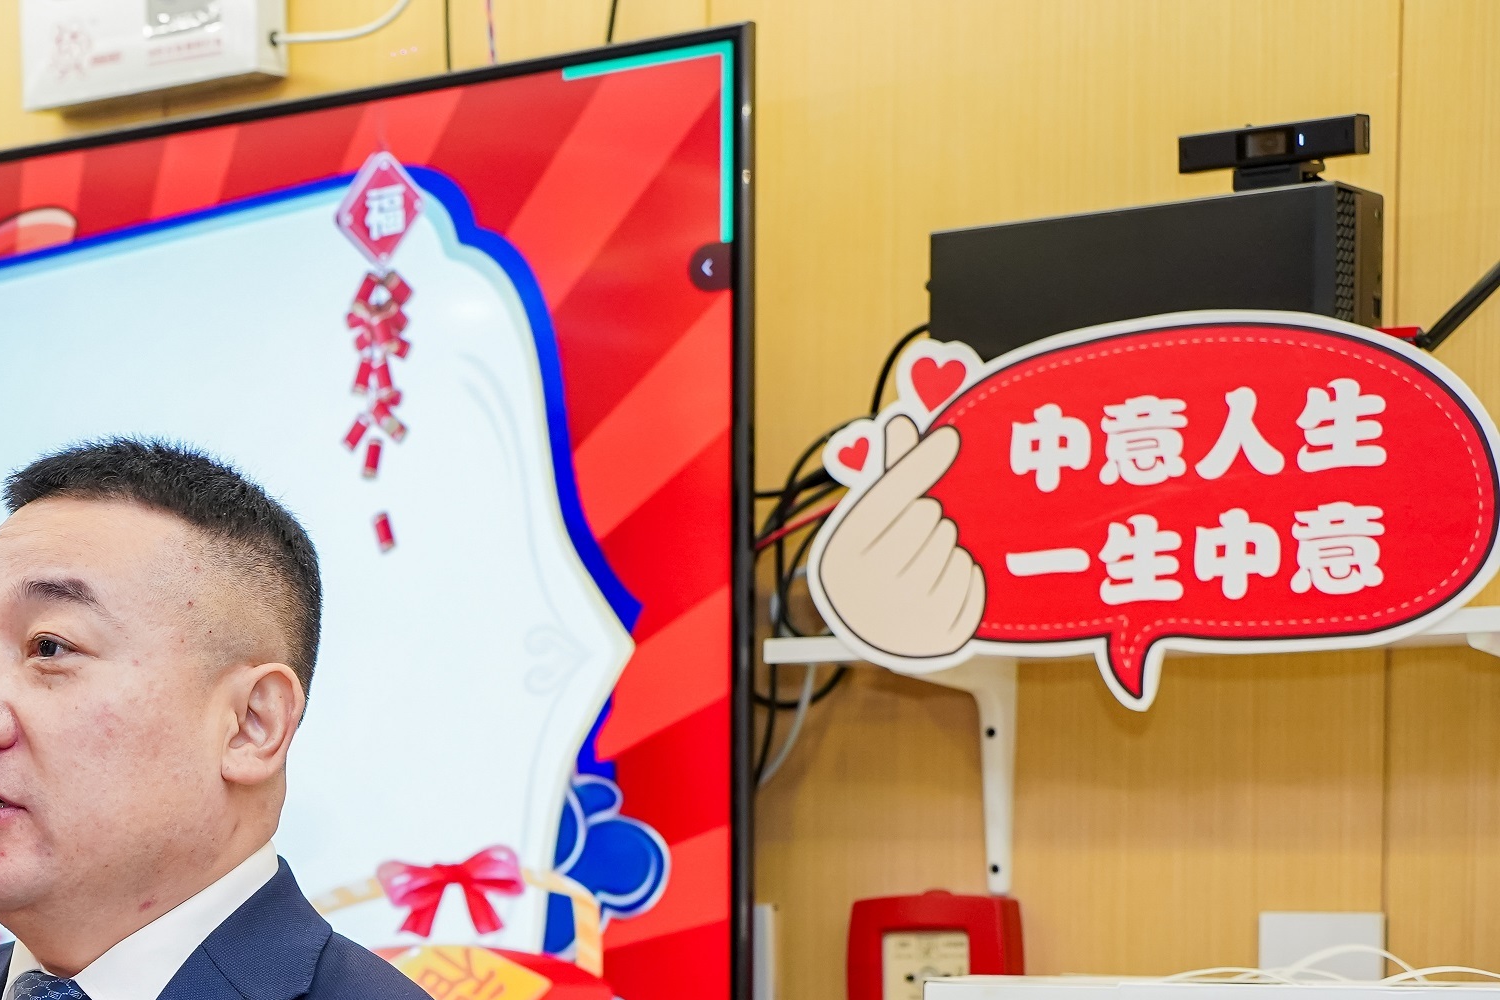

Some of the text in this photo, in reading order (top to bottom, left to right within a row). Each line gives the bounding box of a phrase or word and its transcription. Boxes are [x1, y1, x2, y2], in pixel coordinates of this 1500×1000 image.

[1010, 377, 1388, 493] 中意人生
[1005, 501, 1386, 606] 一生中意
